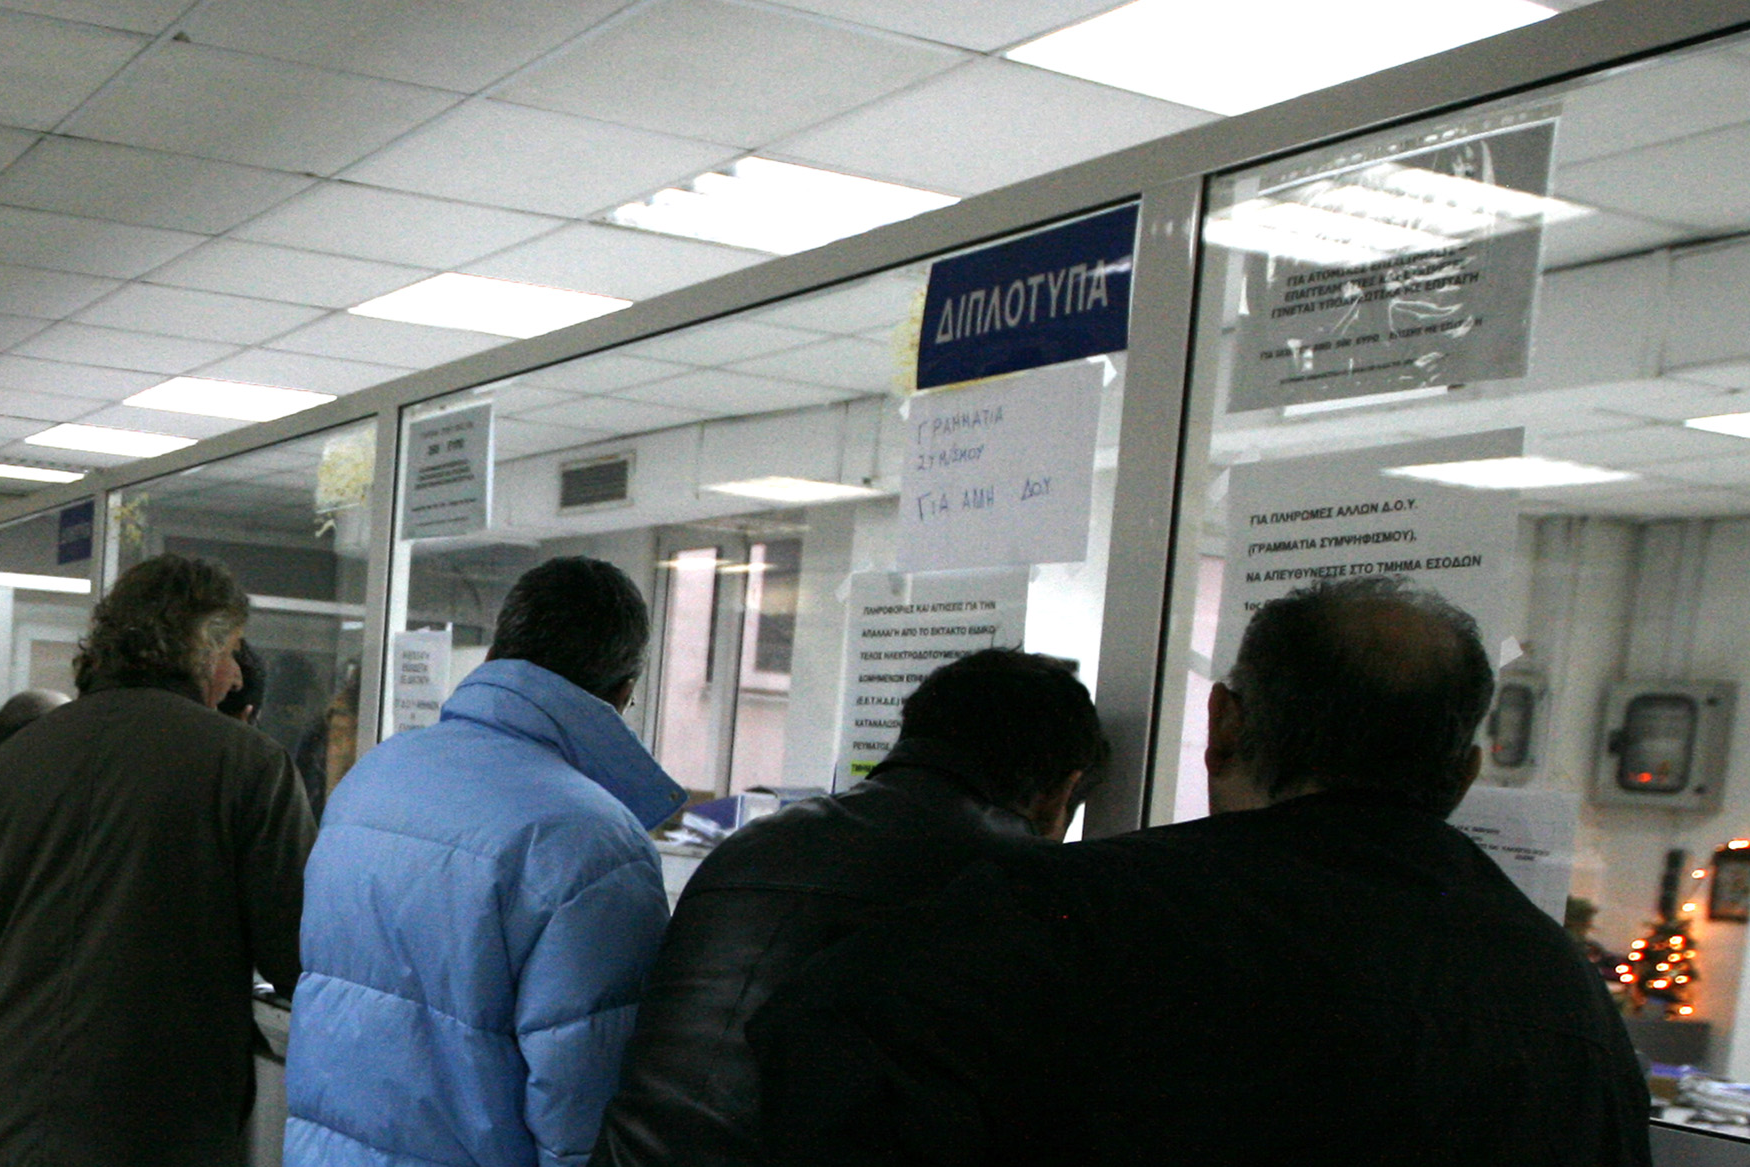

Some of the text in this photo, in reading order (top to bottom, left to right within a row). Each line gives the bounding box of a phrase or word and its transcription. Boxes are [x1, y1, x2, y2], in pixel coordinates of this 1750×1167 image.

[935, 259, 1108, 345] ΔΙΠΛΟΤΥΠΑ
[916, 491, 949, 522] ΓΙΑ
[1250, 514, 1269, 526] ΓΙΑ
[1336, 502, 1380, 518] ΑΛΛΩΝ
[1248, 537, 1317, 557] (ΓΡΑΜΜΑΤΙΑ
[1245, 555, 1482, 583] ΝΑ ΑΠΕΥΘΥΝΕΣΤΕ ΣΤΟ ΤΜΗΜΑ ΕΣΟΔΩΝ
[980, 600, 996, 611] ΤΗΝ
[918, 627, 929, 637] ΤΟ
